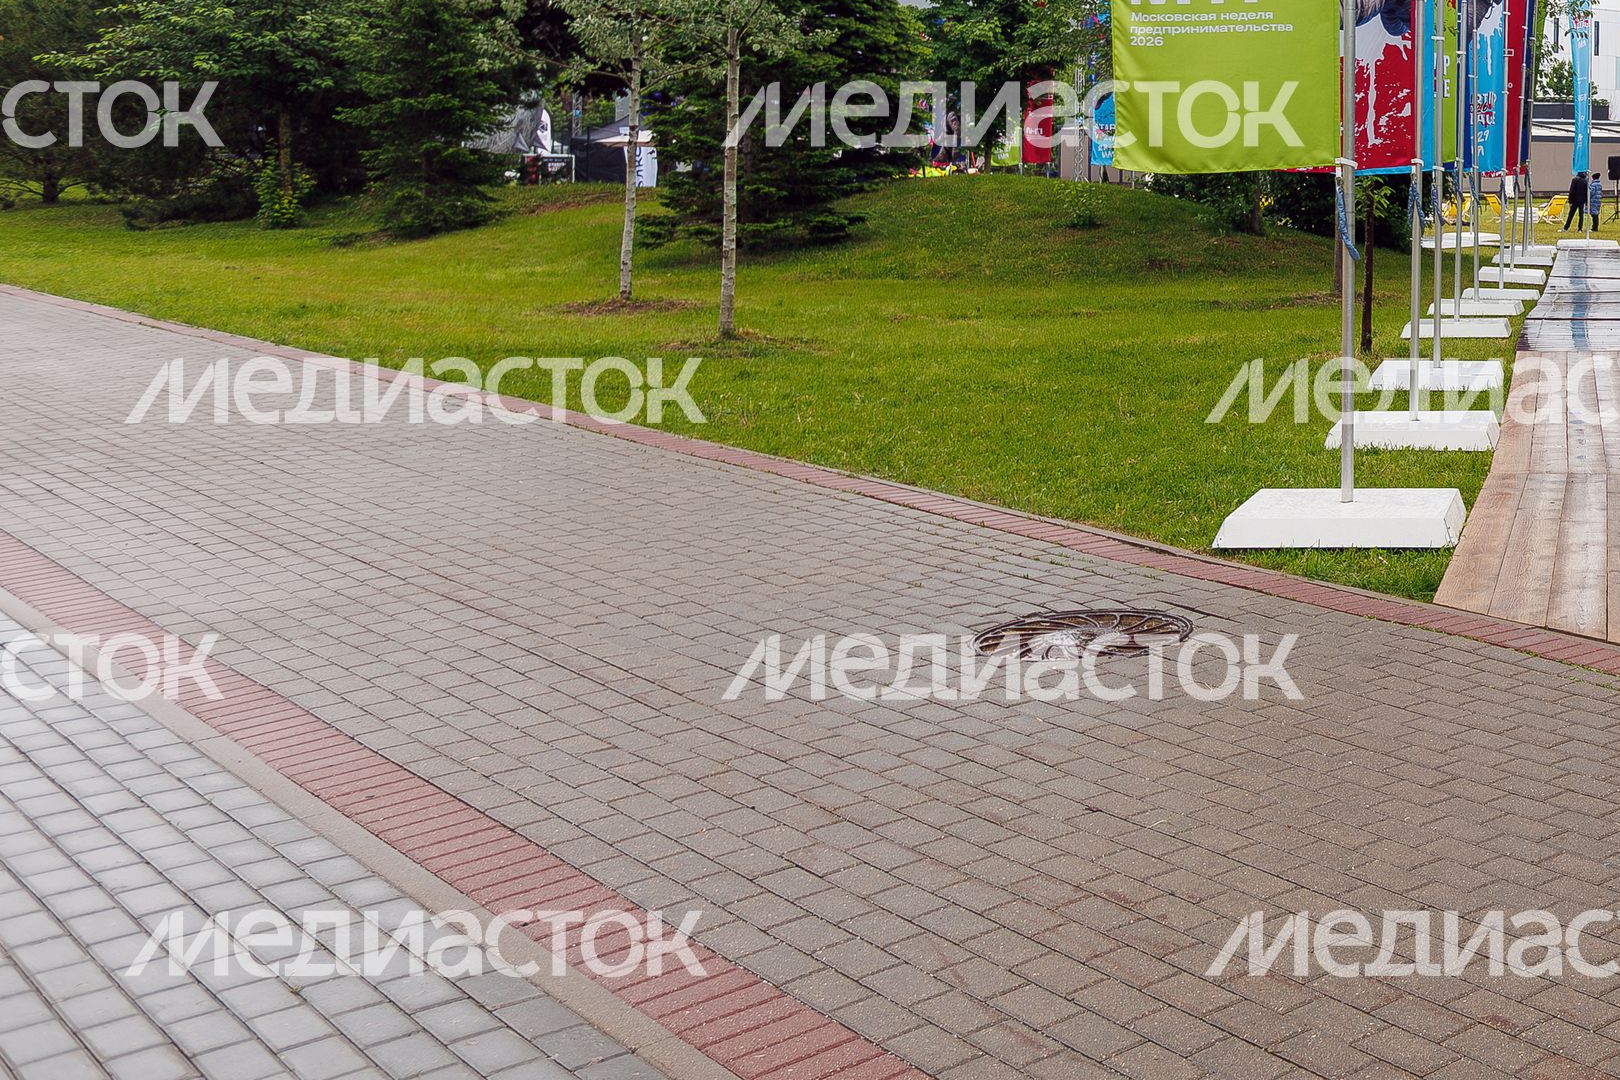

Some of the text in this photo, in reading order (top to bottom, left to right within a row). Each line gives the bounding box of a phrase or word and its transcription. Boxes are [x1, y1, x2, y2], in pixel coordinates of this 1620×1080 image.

[1130, 11, 1274, 23] Московская неделя
[1130, 23, 1294, 36] предпринимательства
[1130, 37, 1164, 47] 2026
